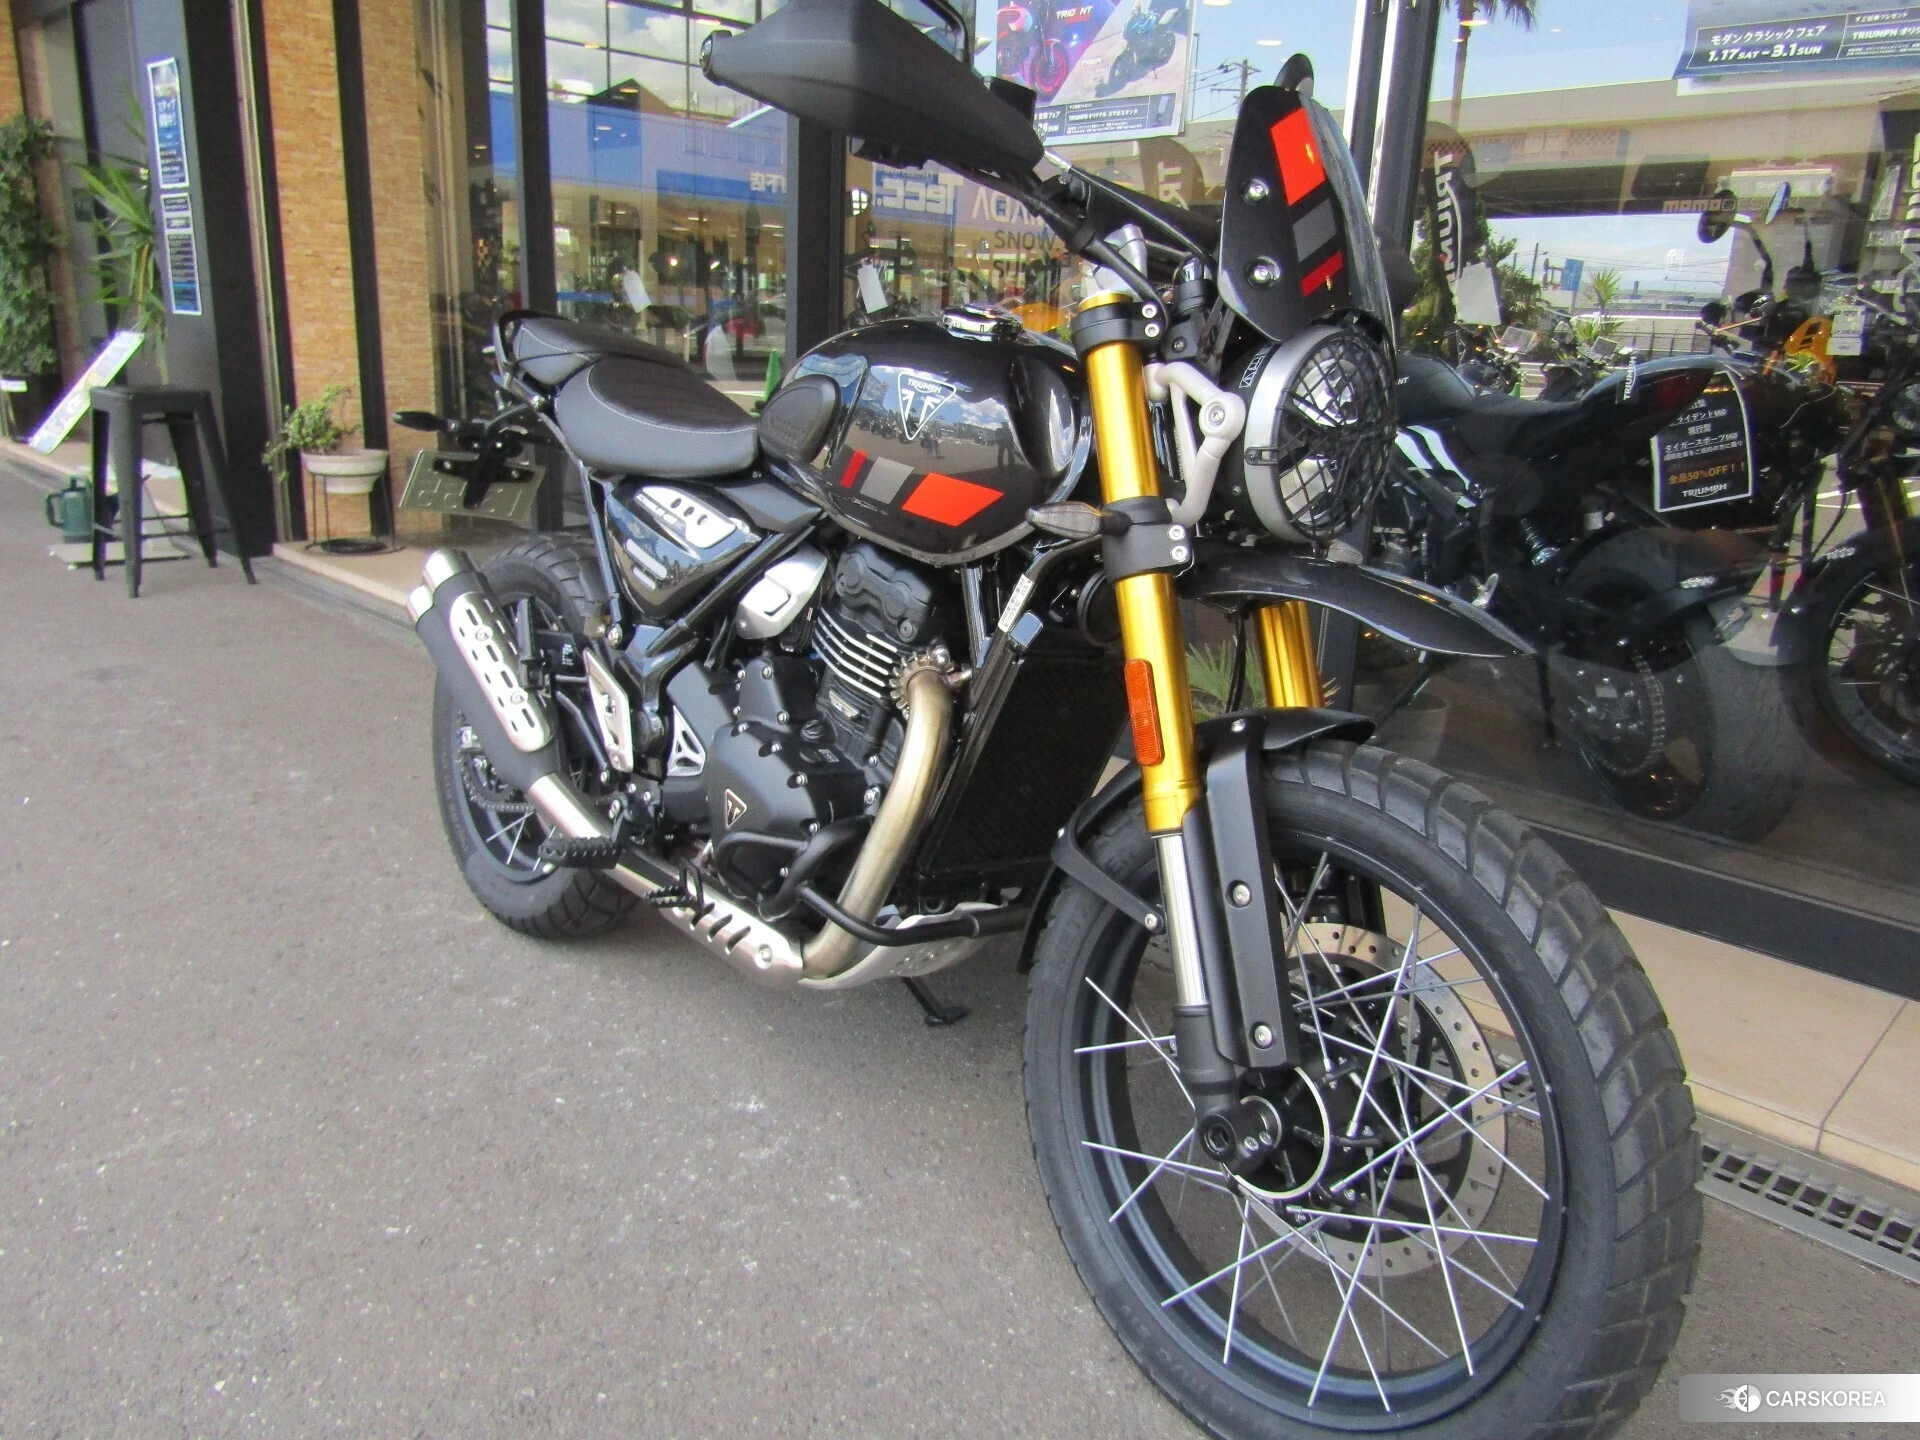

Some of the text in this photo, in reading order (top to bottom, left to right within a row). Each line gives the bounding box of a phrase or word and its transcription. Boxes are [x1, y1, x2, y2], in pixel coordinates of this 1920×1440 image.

[1056, 5, 1094, 20] TRIDNT
[1711, 25, 1827, 46] モダンクラシックフェア
[908, 378, 943, 394] TRIUMPH
[1682, 483, 1728, 498] TRIUMPH
